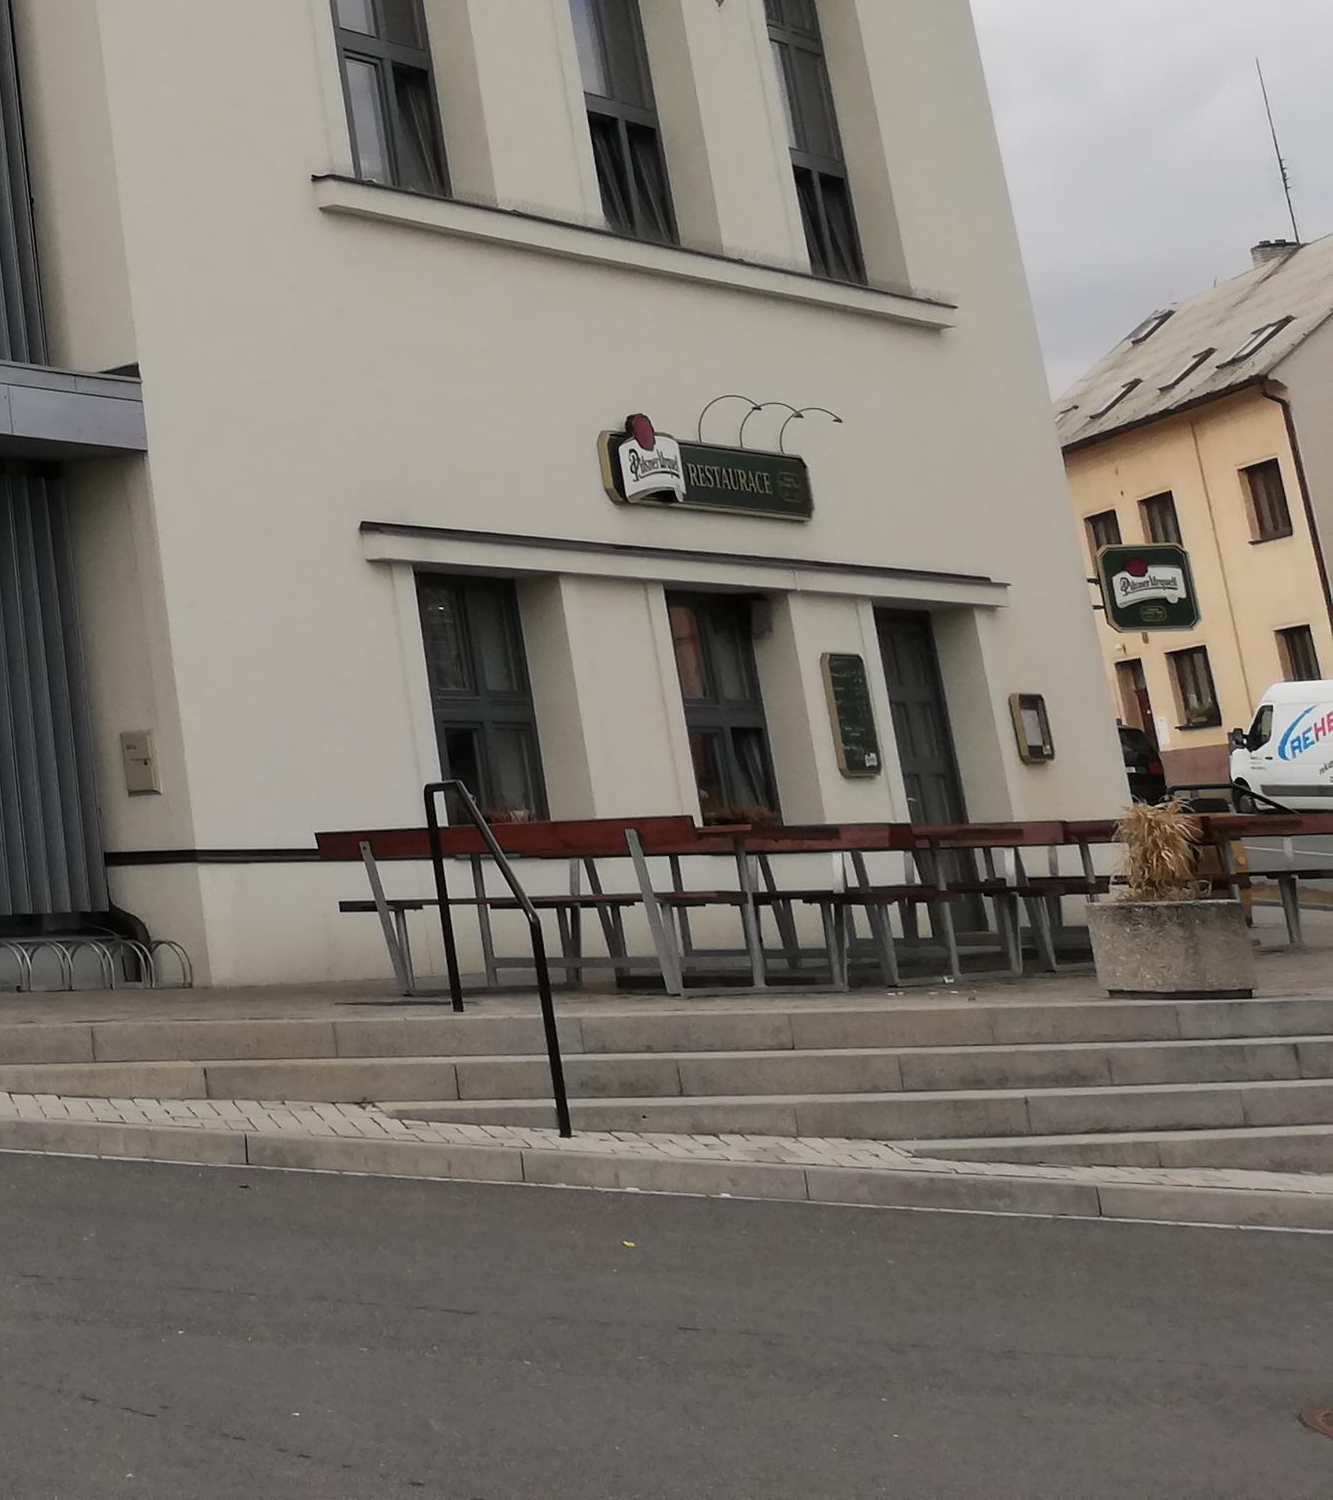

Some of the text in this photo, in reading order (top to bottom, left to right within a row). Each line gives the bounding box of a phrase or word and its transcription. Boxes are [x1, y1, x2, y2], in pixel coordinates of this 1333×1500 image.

[628, 448, 680, 482] Pilsner Urquell
[686, 462, 773, 496] RESTAURACE
[1119, 575, 1178, 597] Pilsner Urquell
